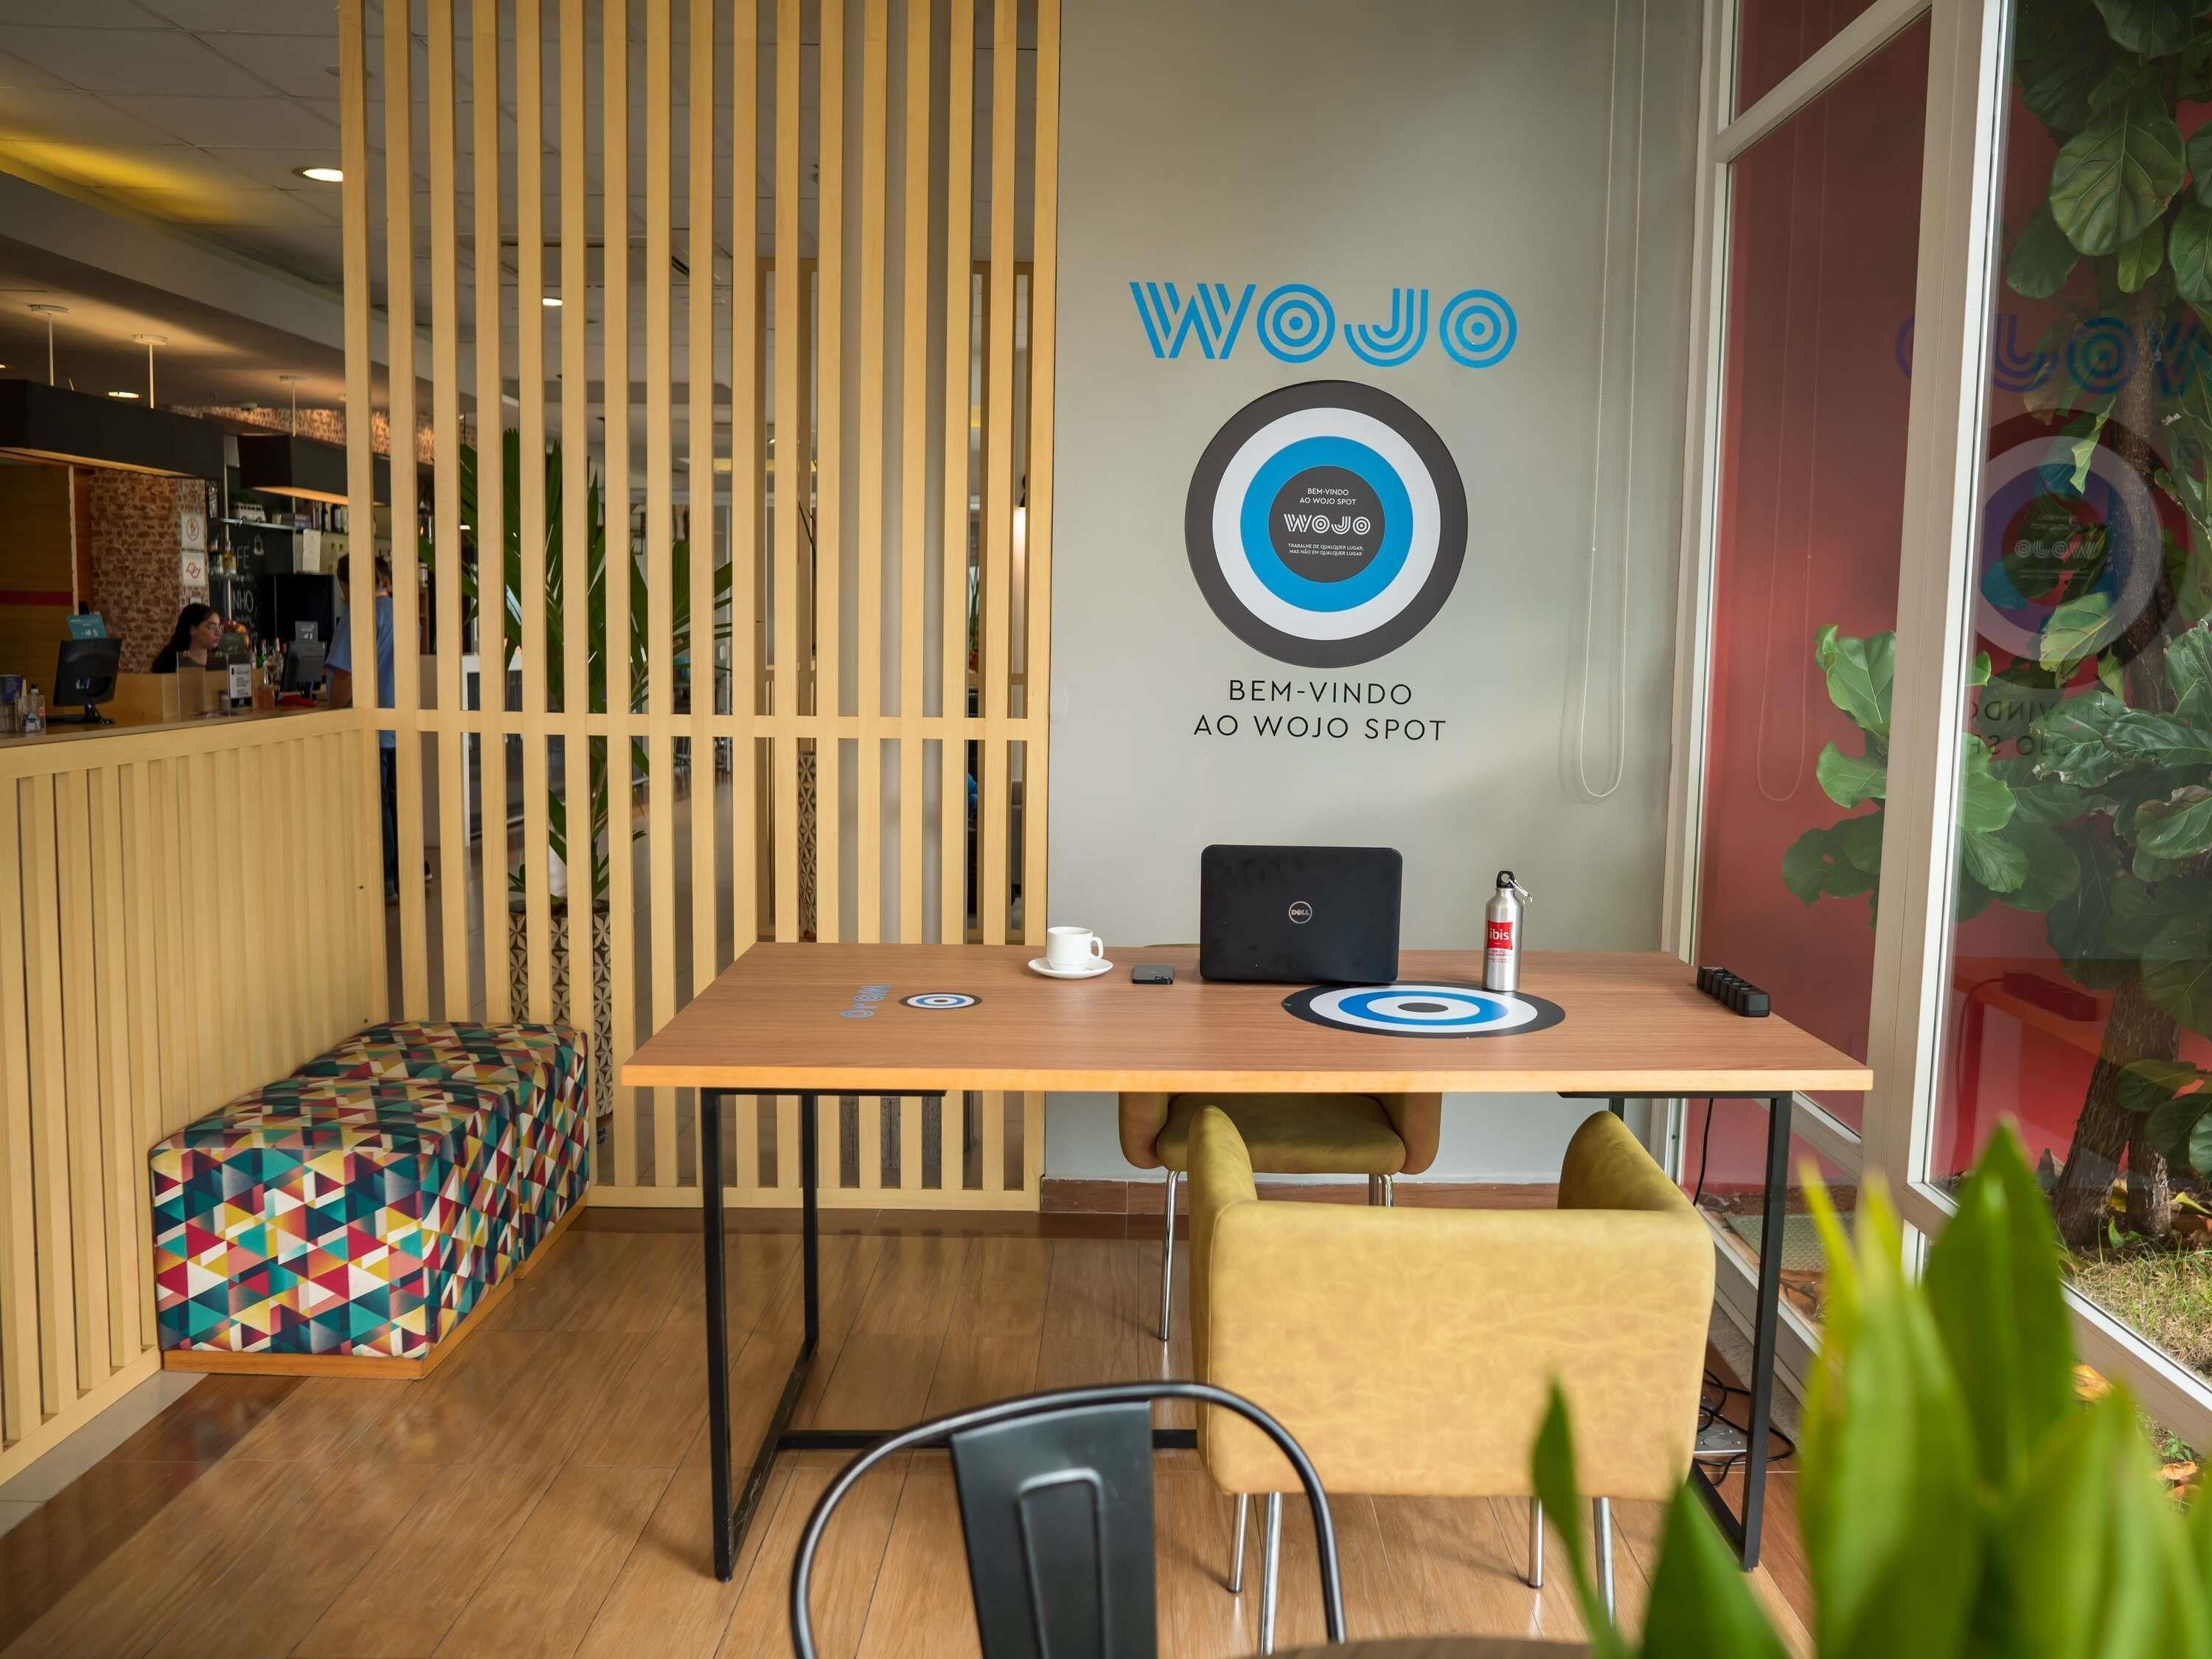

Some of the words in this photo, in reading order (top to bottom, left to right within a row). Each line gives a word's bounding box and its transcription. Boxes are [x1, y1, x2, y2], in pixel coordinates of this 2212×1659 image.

[1130, 282, 1518, 369] WOJO
[1307, 488, 1349, 496] BEM-VINDO
[1283, 513, 1371, 535] WOJO
[1229, 680, 1412, 705] BEM-VINDO
[1194, 714, 1239, 737] AO
[1253, 715, 1349, 739] WOJO
[1364, 718, 1446, 741] SPOT
[1489, 928, 1510, 941] ibis
